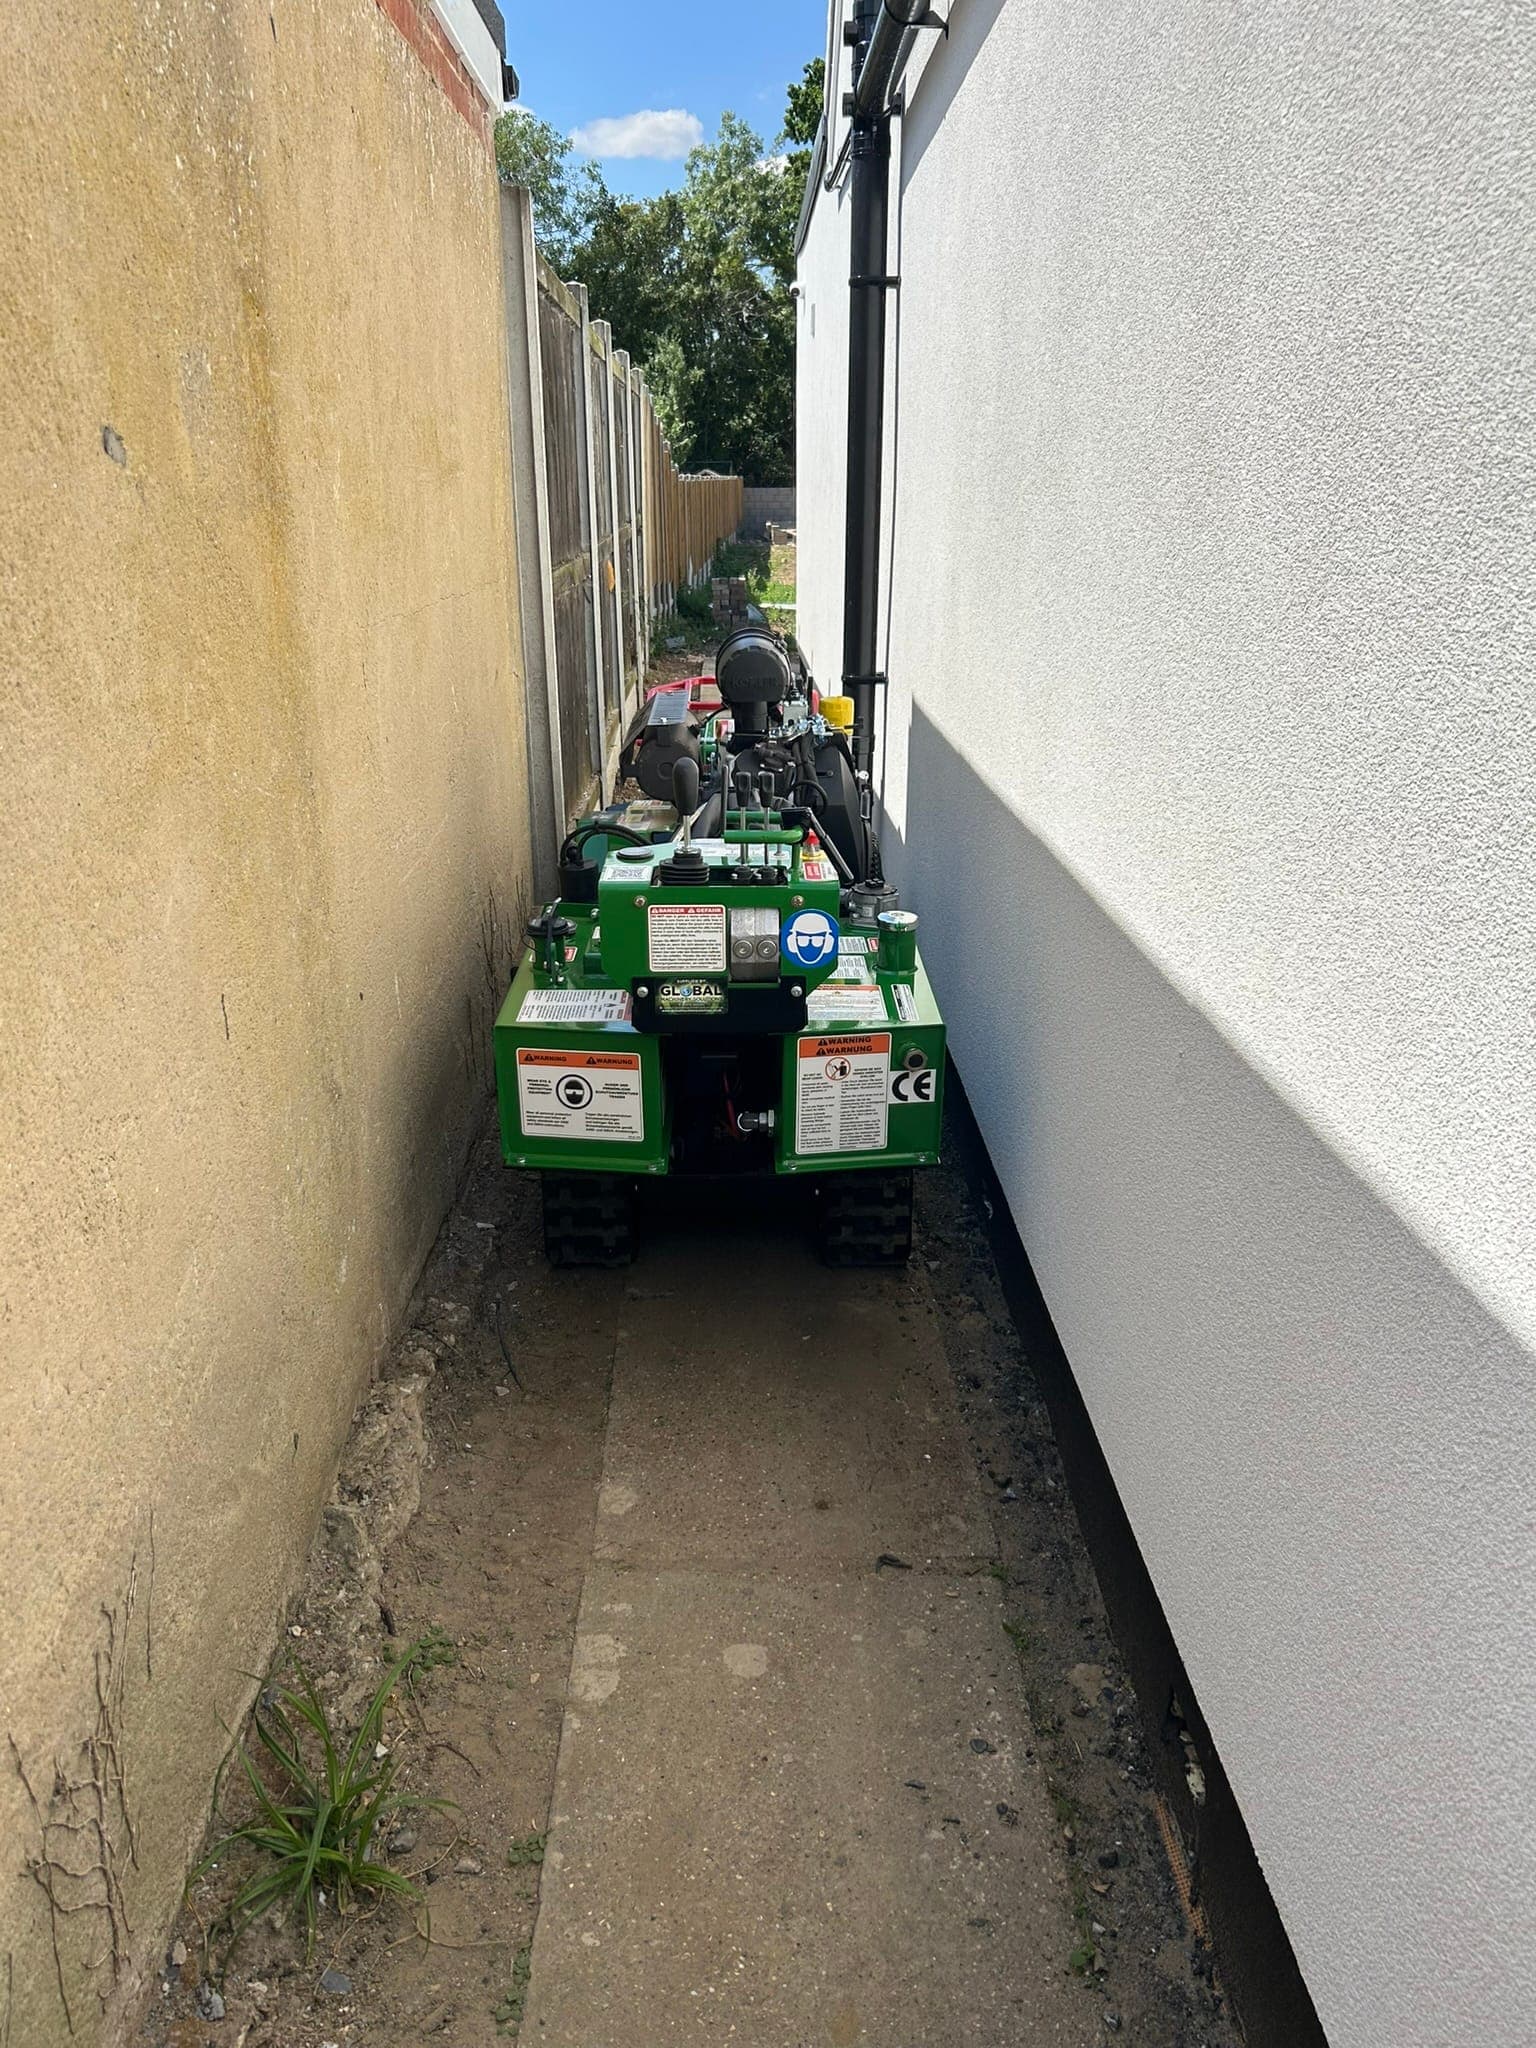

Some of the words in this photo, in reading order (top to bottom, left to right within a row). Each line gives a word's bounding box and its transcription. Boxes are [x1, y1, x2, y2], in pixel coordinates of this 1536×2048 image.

[660, 985, 723, 997] GLOBAL
[828, 1036, 872, 1045] WARNING
[826, 1046, 873, 1054] WARNUNG
[892, 1071, 931, 1101] CE
